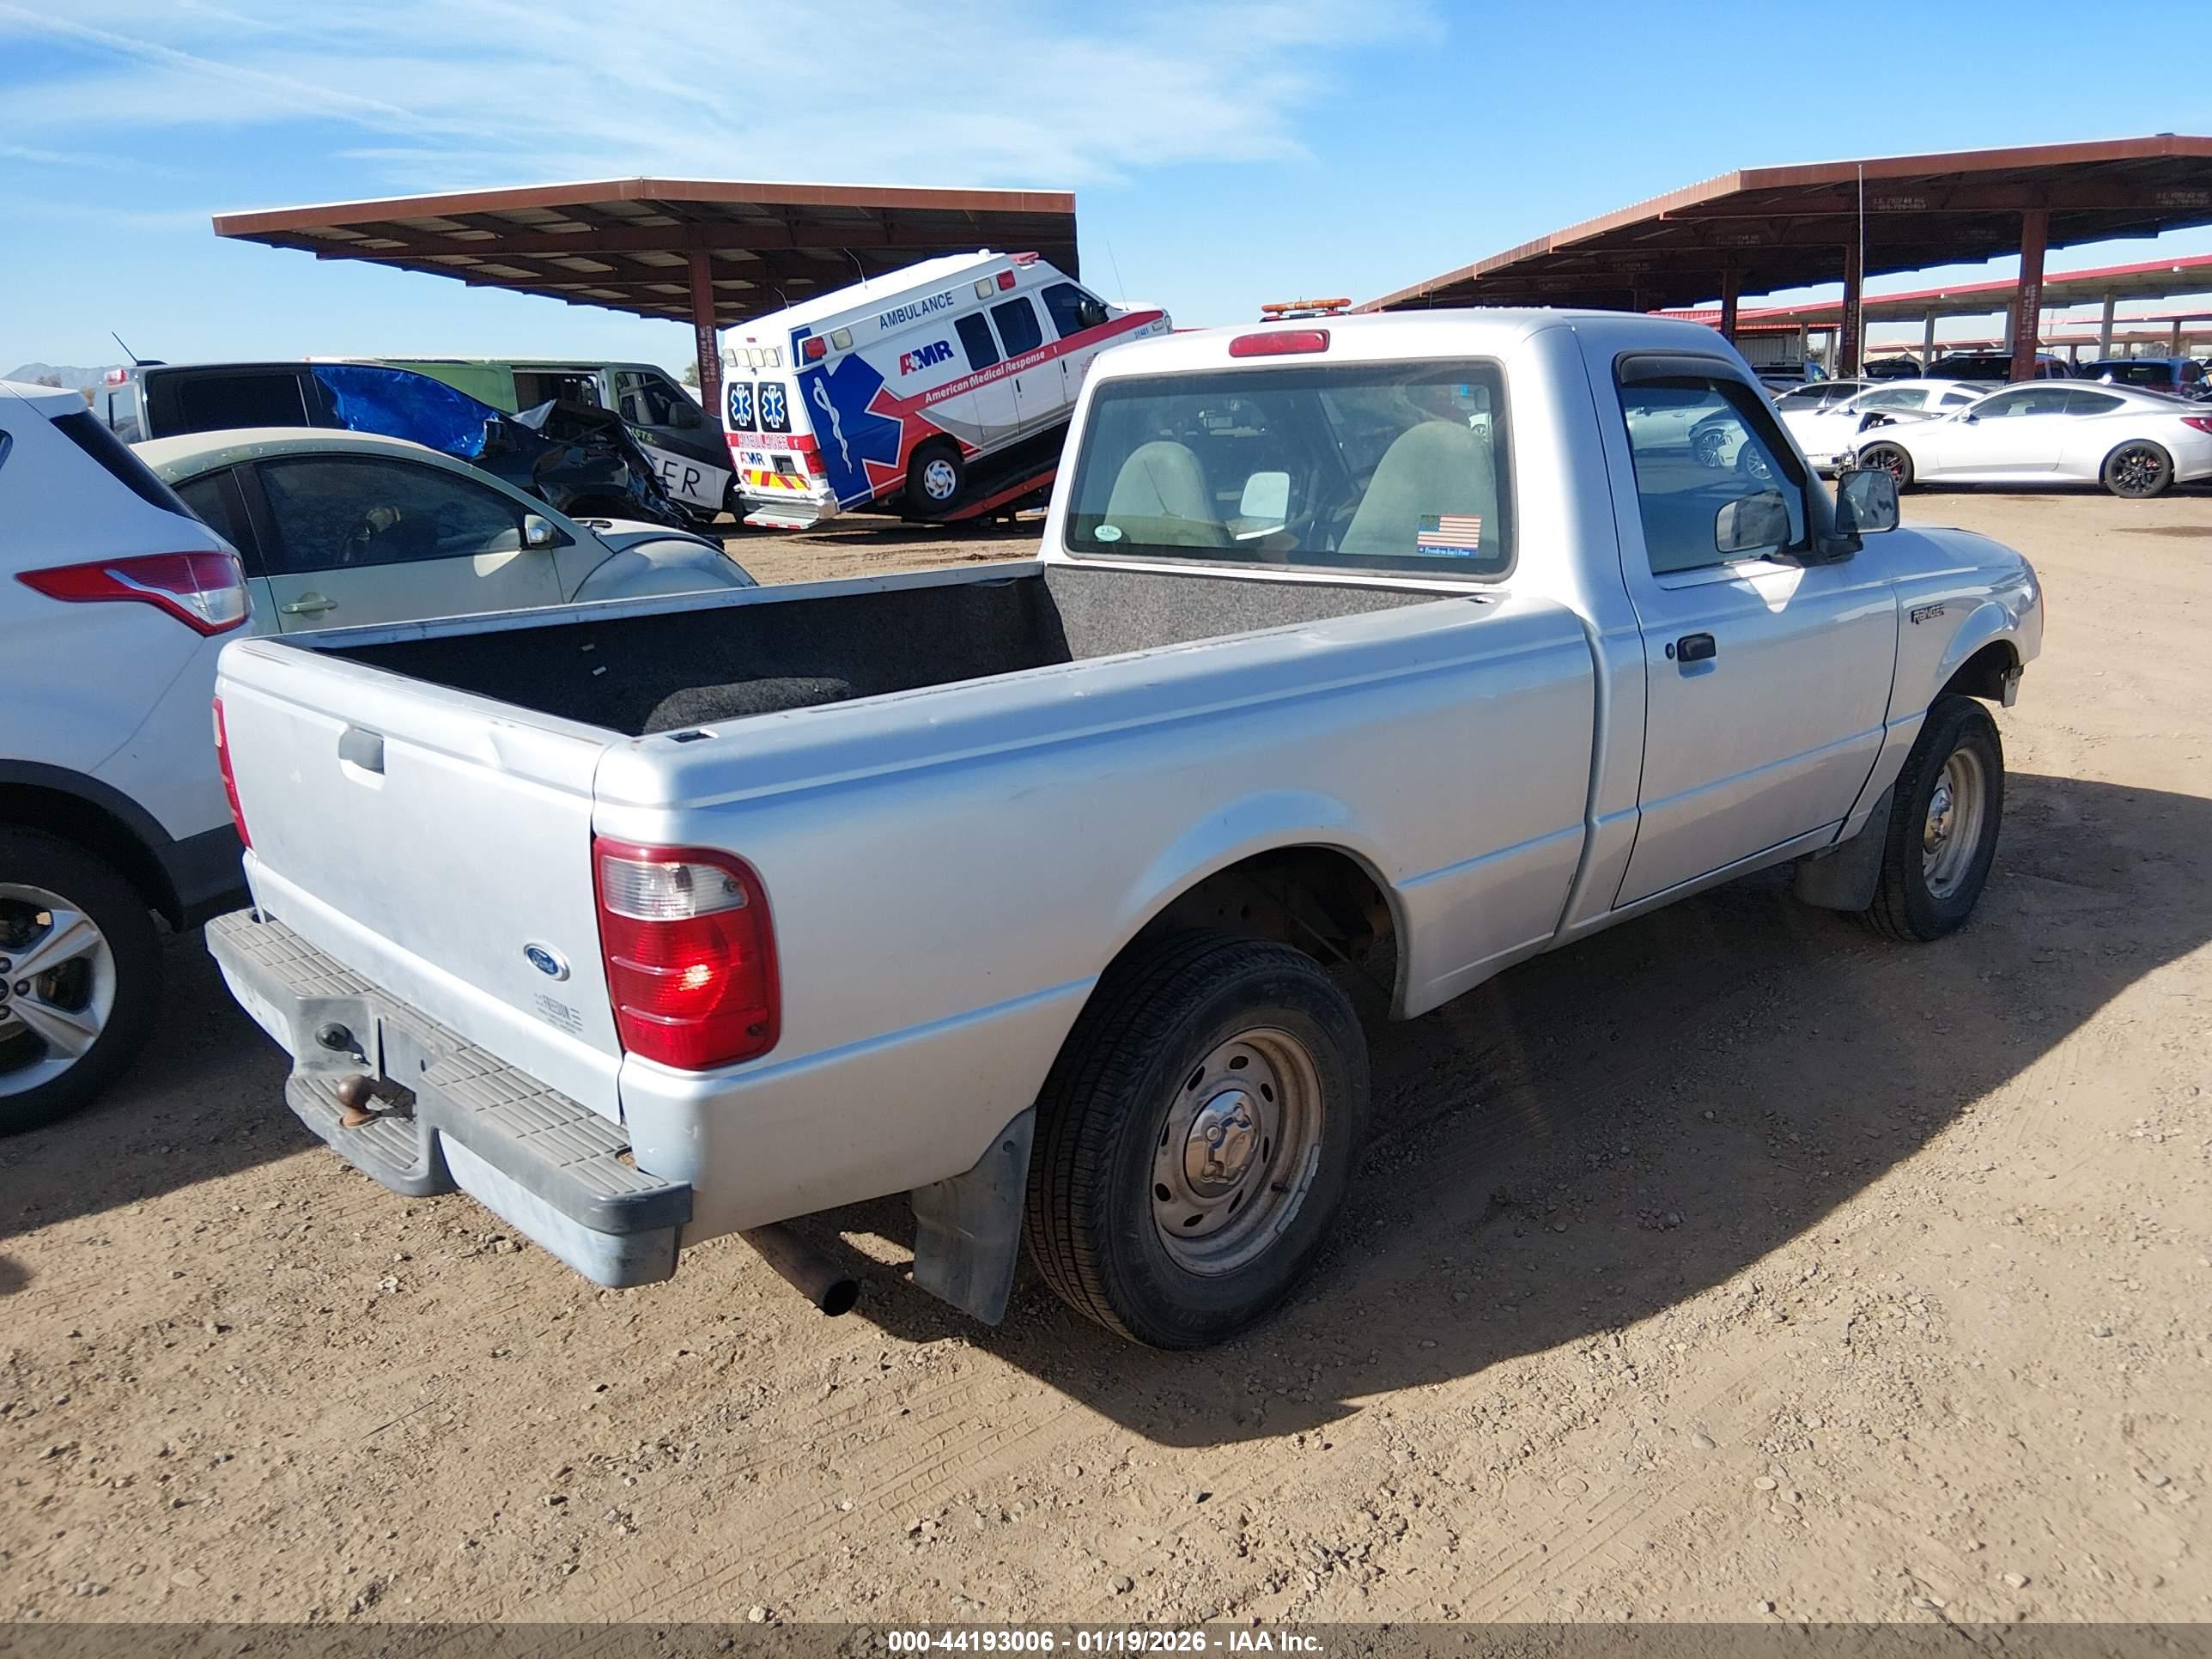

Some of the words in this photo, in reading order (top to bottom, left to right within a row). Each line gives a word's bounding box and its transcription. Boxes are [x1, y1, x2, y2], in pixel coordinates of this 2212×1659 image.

[879, 291, 954, 330] AMBULANCE
[899, 339, 955, 376] AMR
[925, 380, 969, 404] American
[969, 365, 1005, 387] Medical
[1005, 349, 1045, 373] Response
[738, 433, 789, 450] AMBULANCE
[650, 455, 701, 498] ER
[528, 948, 558, 974] Ford
